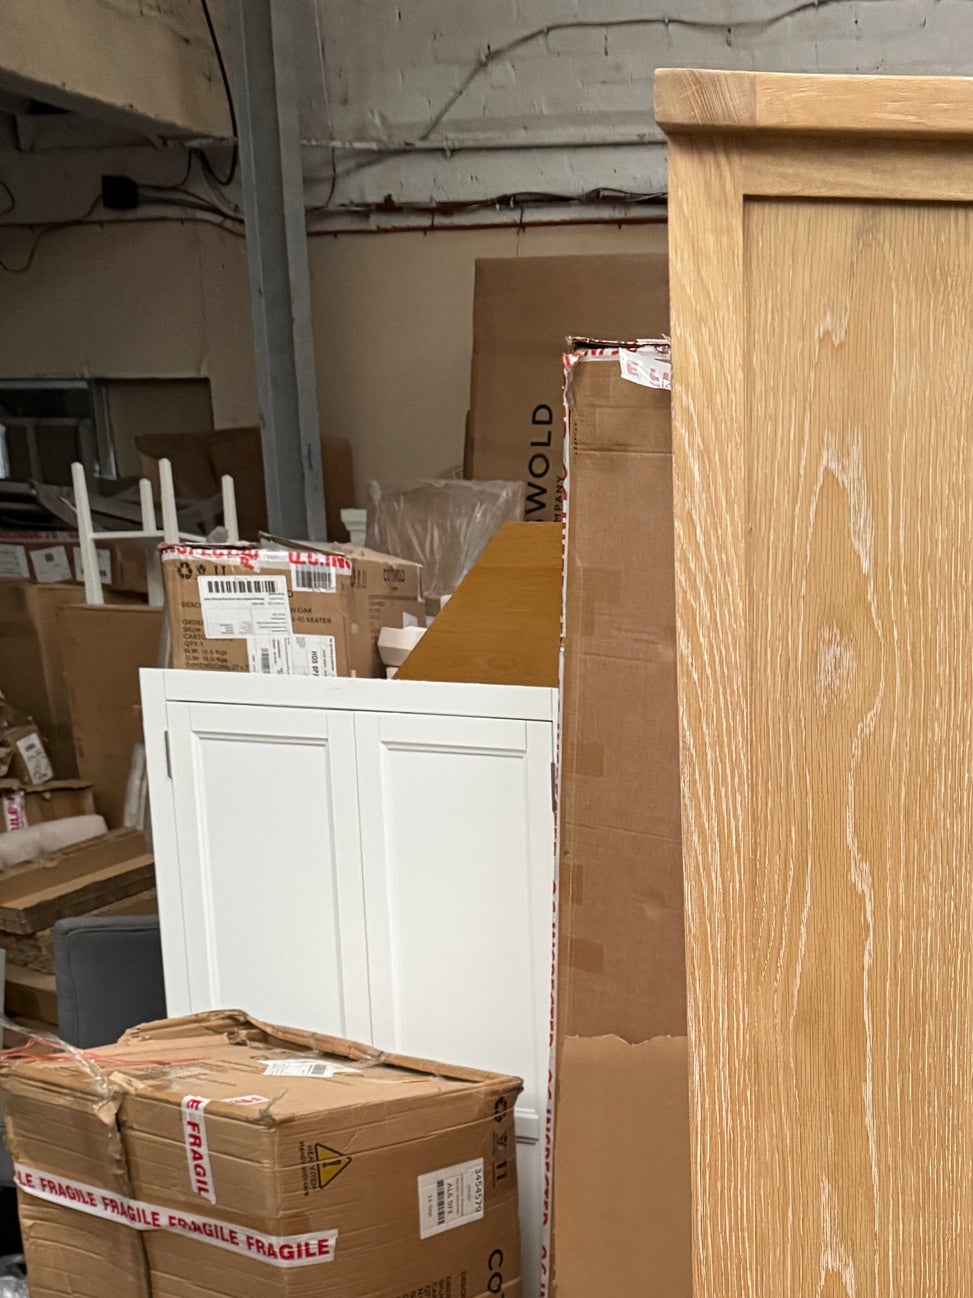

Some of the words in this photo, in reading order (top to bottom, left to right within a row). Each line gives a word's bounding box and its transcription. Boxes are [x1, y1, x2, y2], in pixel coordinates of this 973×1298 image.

[525, 403, 553, 521] WOLD
[186, 1120, 210, 1195] FRAGIL
[39, 1177, 98, 1208] FRAGILE
[102, 1196, 161, 1228] FRAGILE
[245, 1236, 331, 1261] FRAGILE
